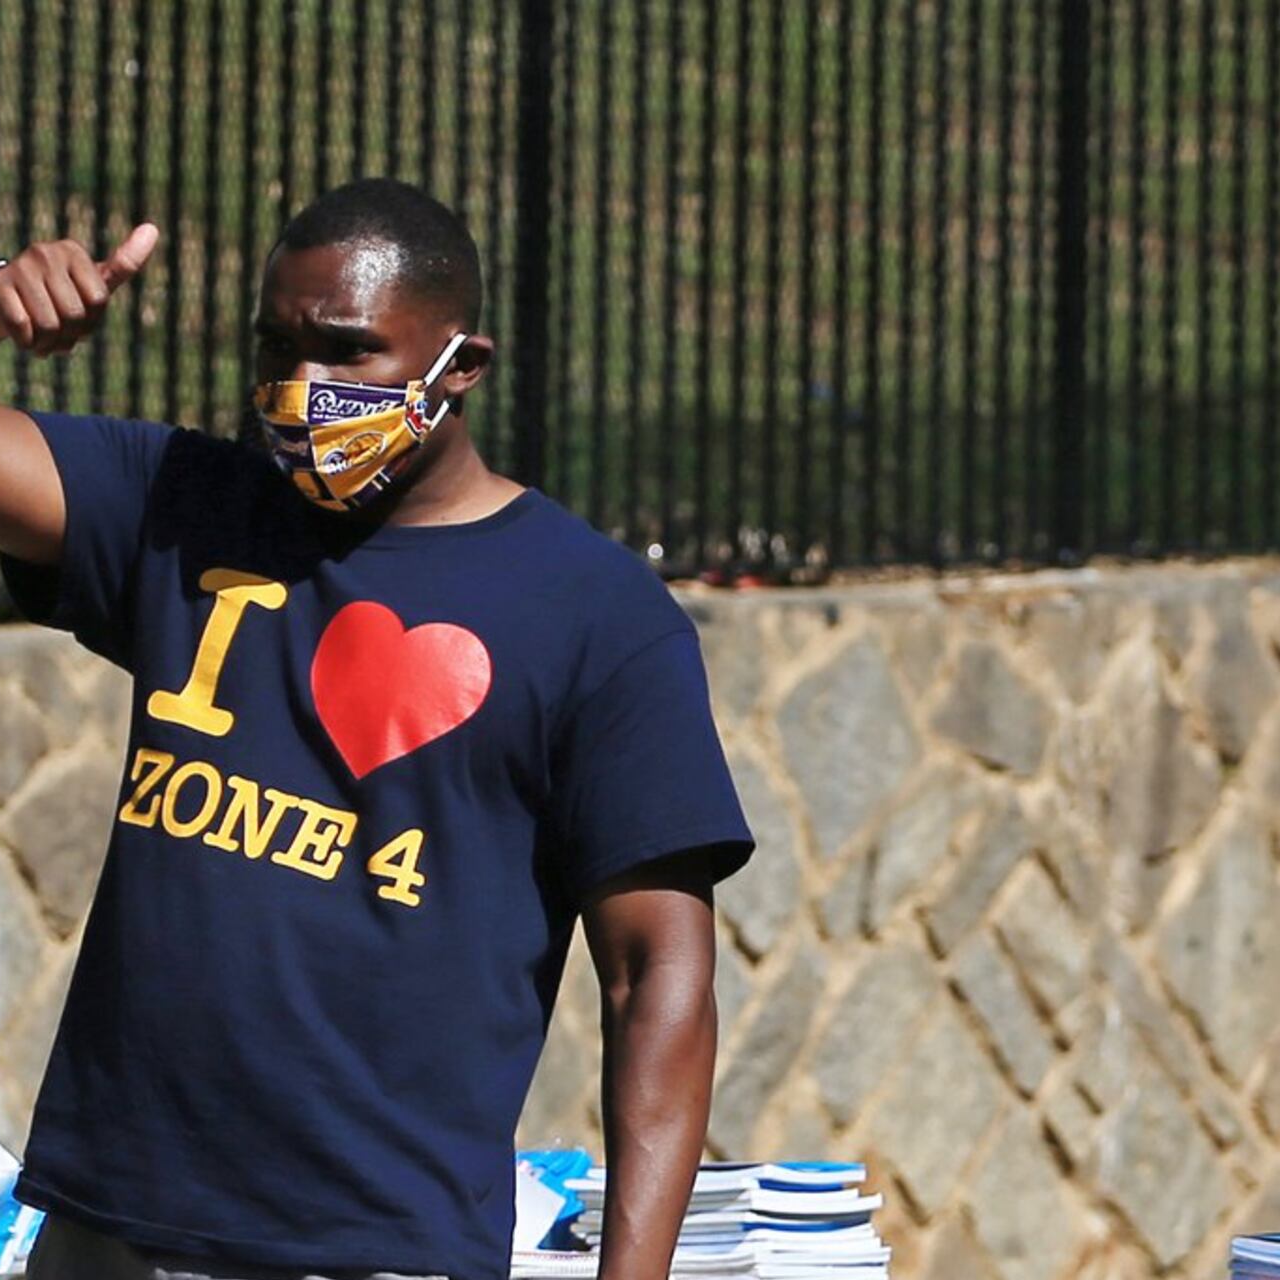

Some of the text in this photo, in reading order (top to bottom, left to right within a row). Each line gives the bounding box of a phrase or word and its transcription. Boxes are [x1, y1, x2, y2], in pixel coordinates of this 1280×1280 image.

[147, 568, 288, 737] I
[119, 747, 426, 907] ZONE 4
